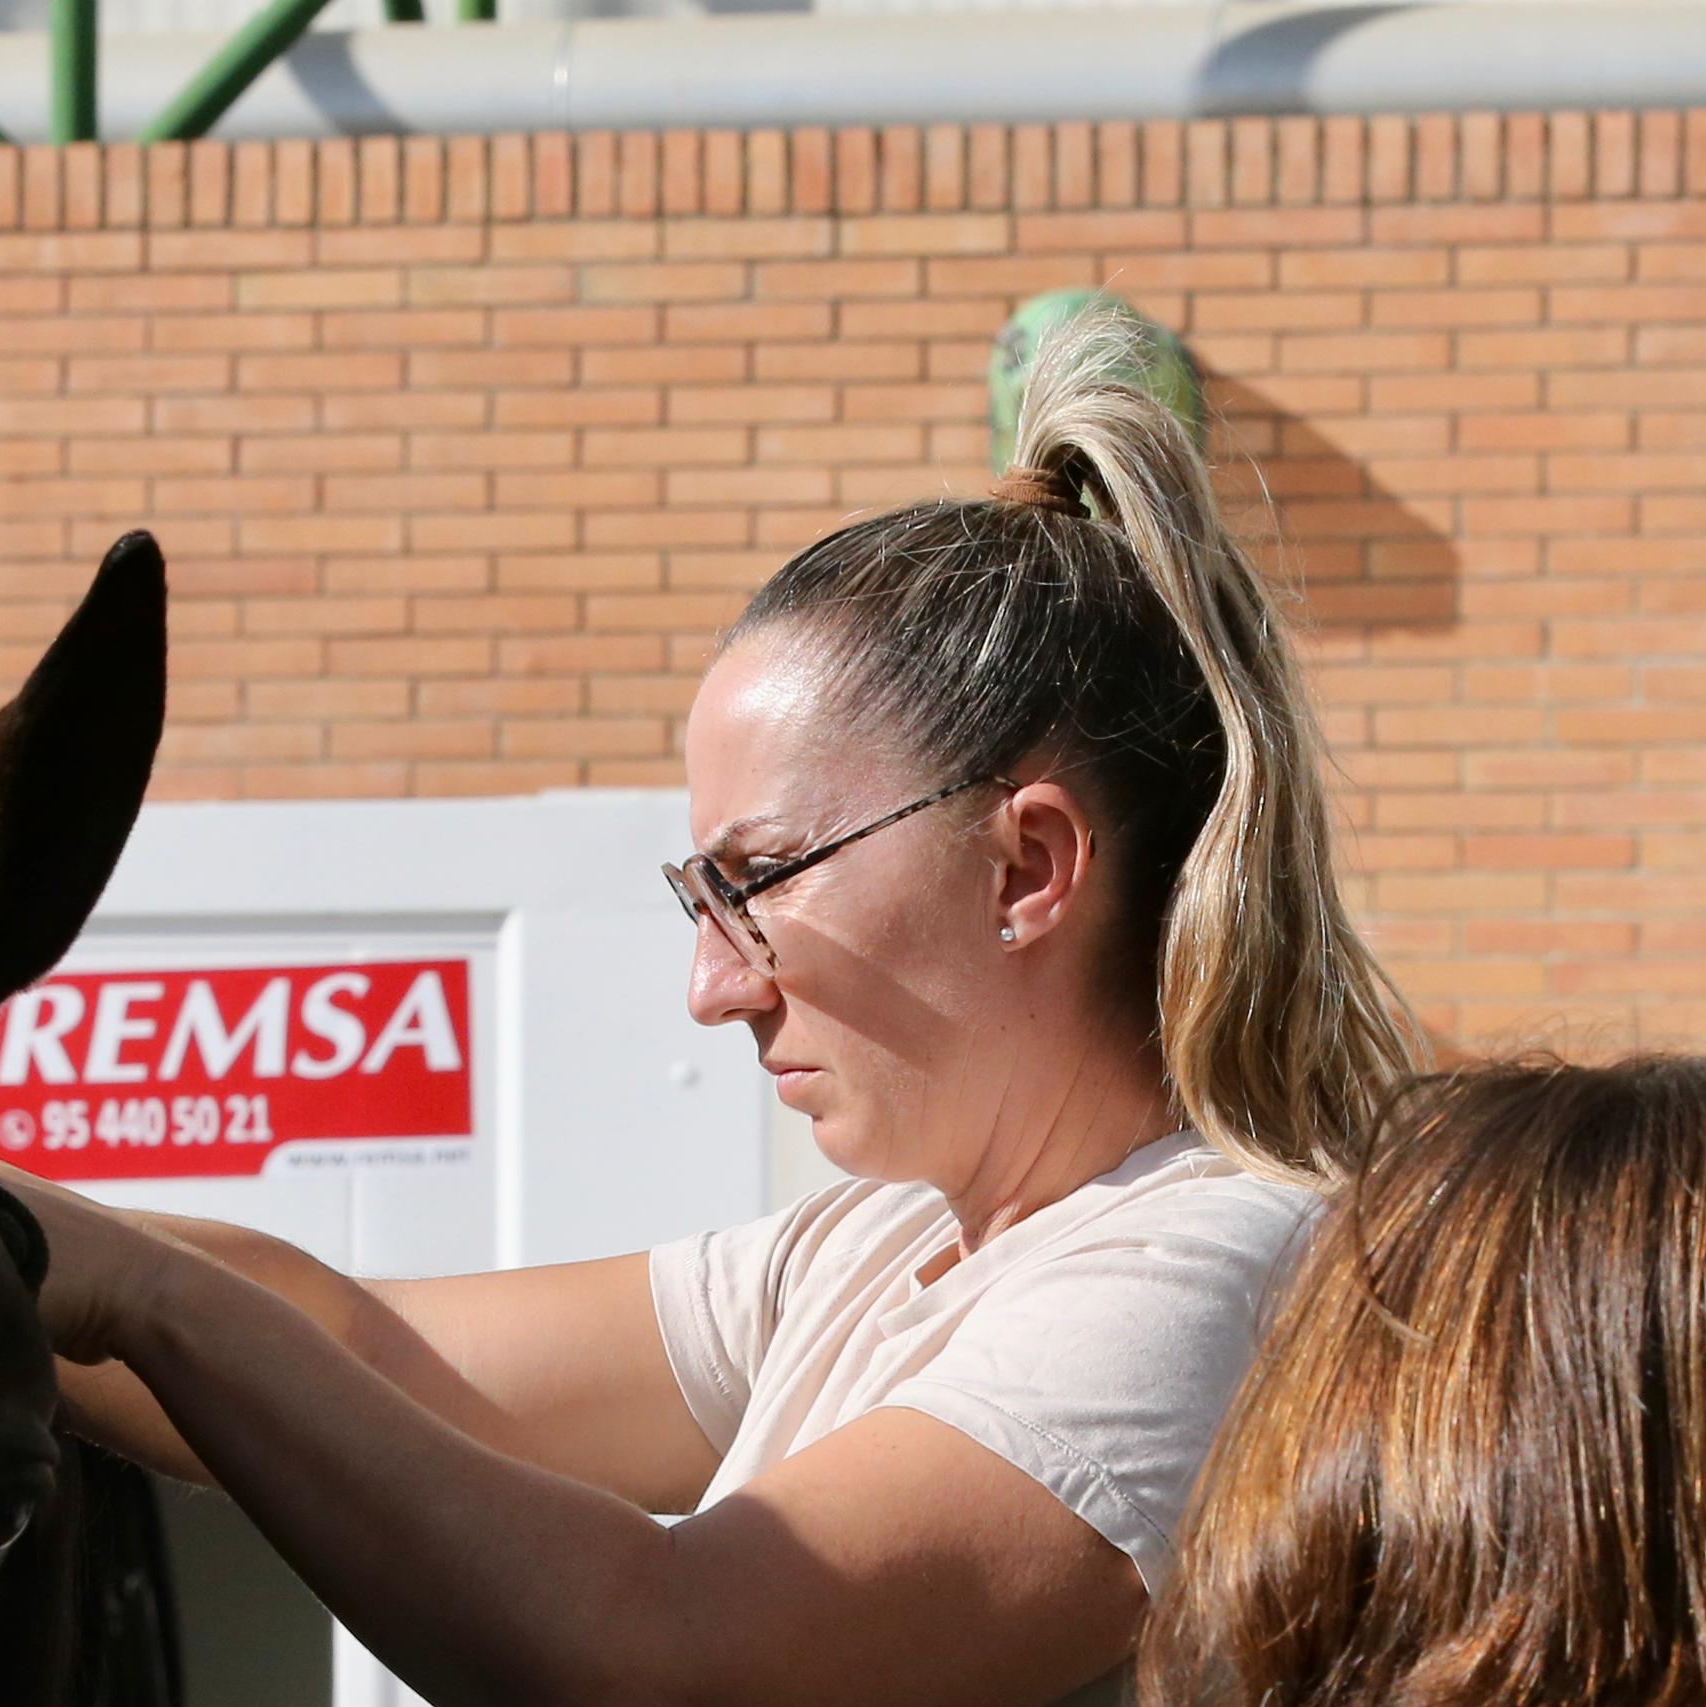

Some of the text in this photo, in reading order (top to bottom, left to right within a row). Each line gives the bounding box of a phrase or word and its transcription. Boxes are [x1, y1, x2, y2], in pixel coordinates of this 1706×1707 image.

[42, 1094, 273, 1150] 95 440 50 21
